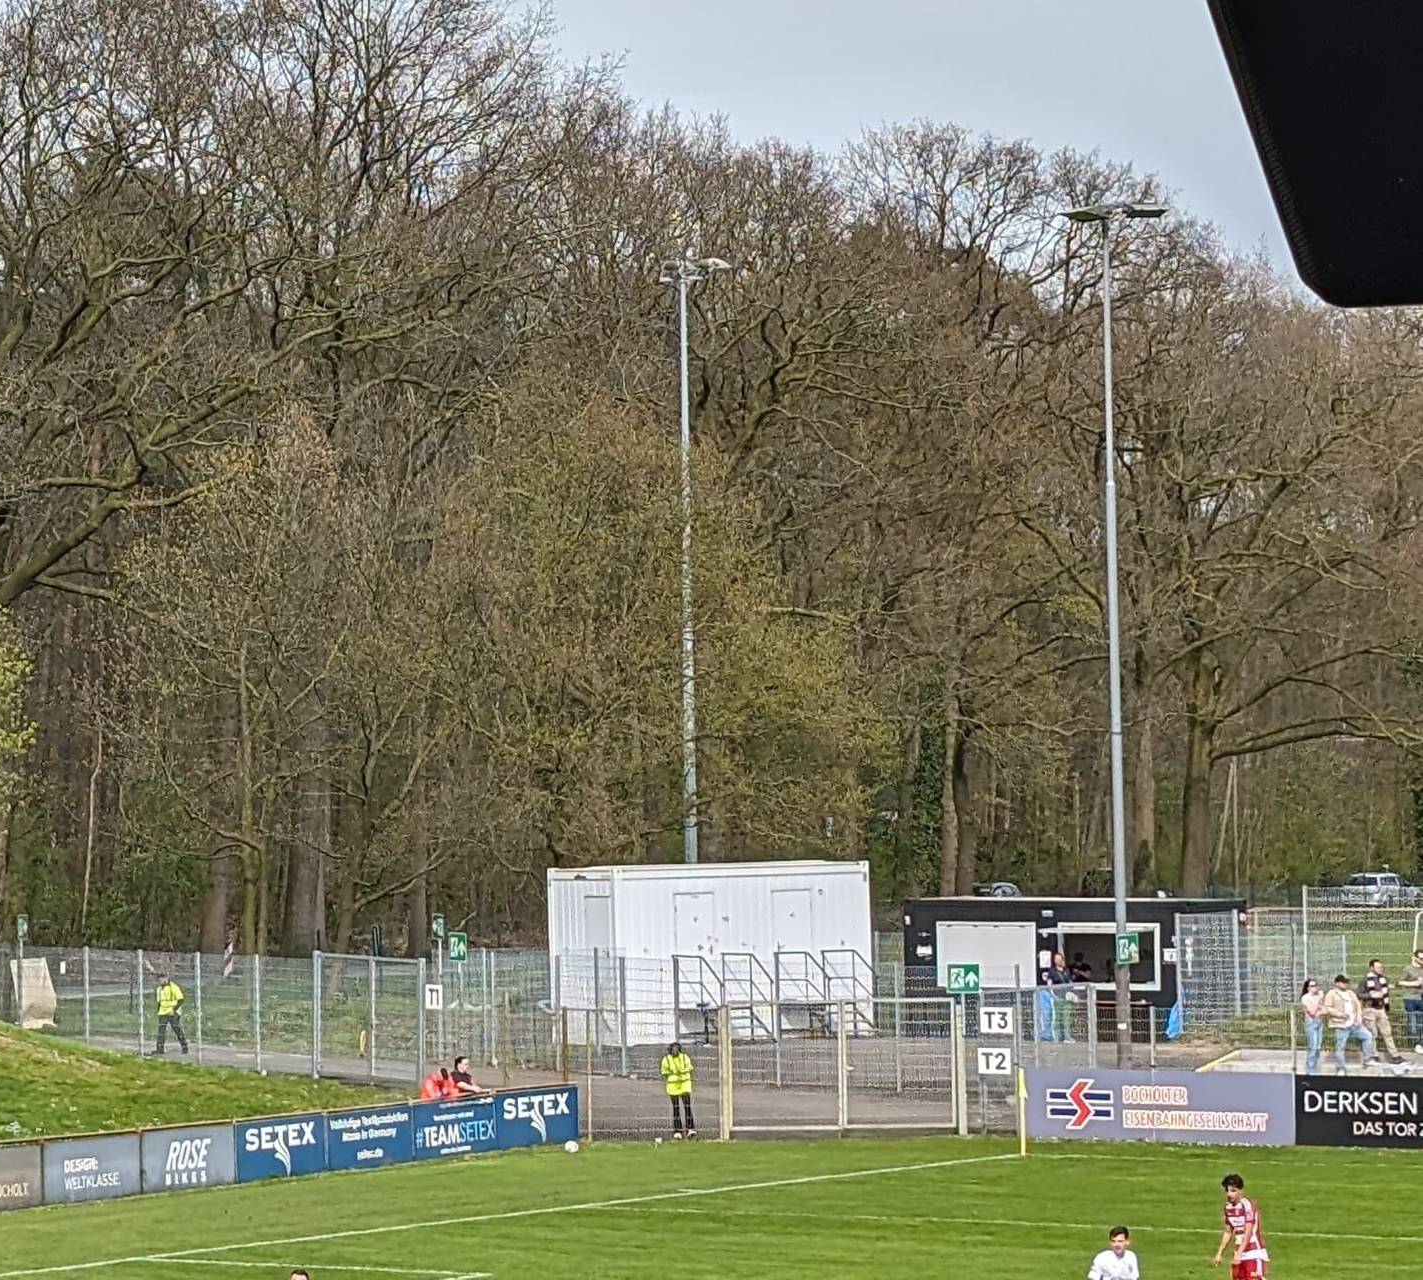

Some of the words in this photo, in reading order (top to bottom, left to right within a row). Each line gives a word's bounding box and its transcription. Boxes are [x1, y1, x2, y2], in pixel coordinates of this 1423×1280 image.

[983, 1013, 1009, 1030] T3
[980, 1052, 1008, 1071] T2
[503, 1091, 570, 1121] SETEX
[1122, 1086, 1188, 1105] BOCHOLTER
[1303, 1090, 1418, 1115] DERKSEN
[1123, 1109, 1268, 1132] EISENBAHNGESELLSCHAFT
[1352, 1121, 1384, 1136] DAS
[1385, 1121, 1418, 1137] TOR
[245, 1121, 317, 1152] SETEX
[416, 1119, 496, 1149] #TEAMSETEX
[165, 1138, 212, 1171] ROSE
[64, 1172, 121, 1191] WELTKLASSE.
[165, 1170, 208, 1186] BIKES
